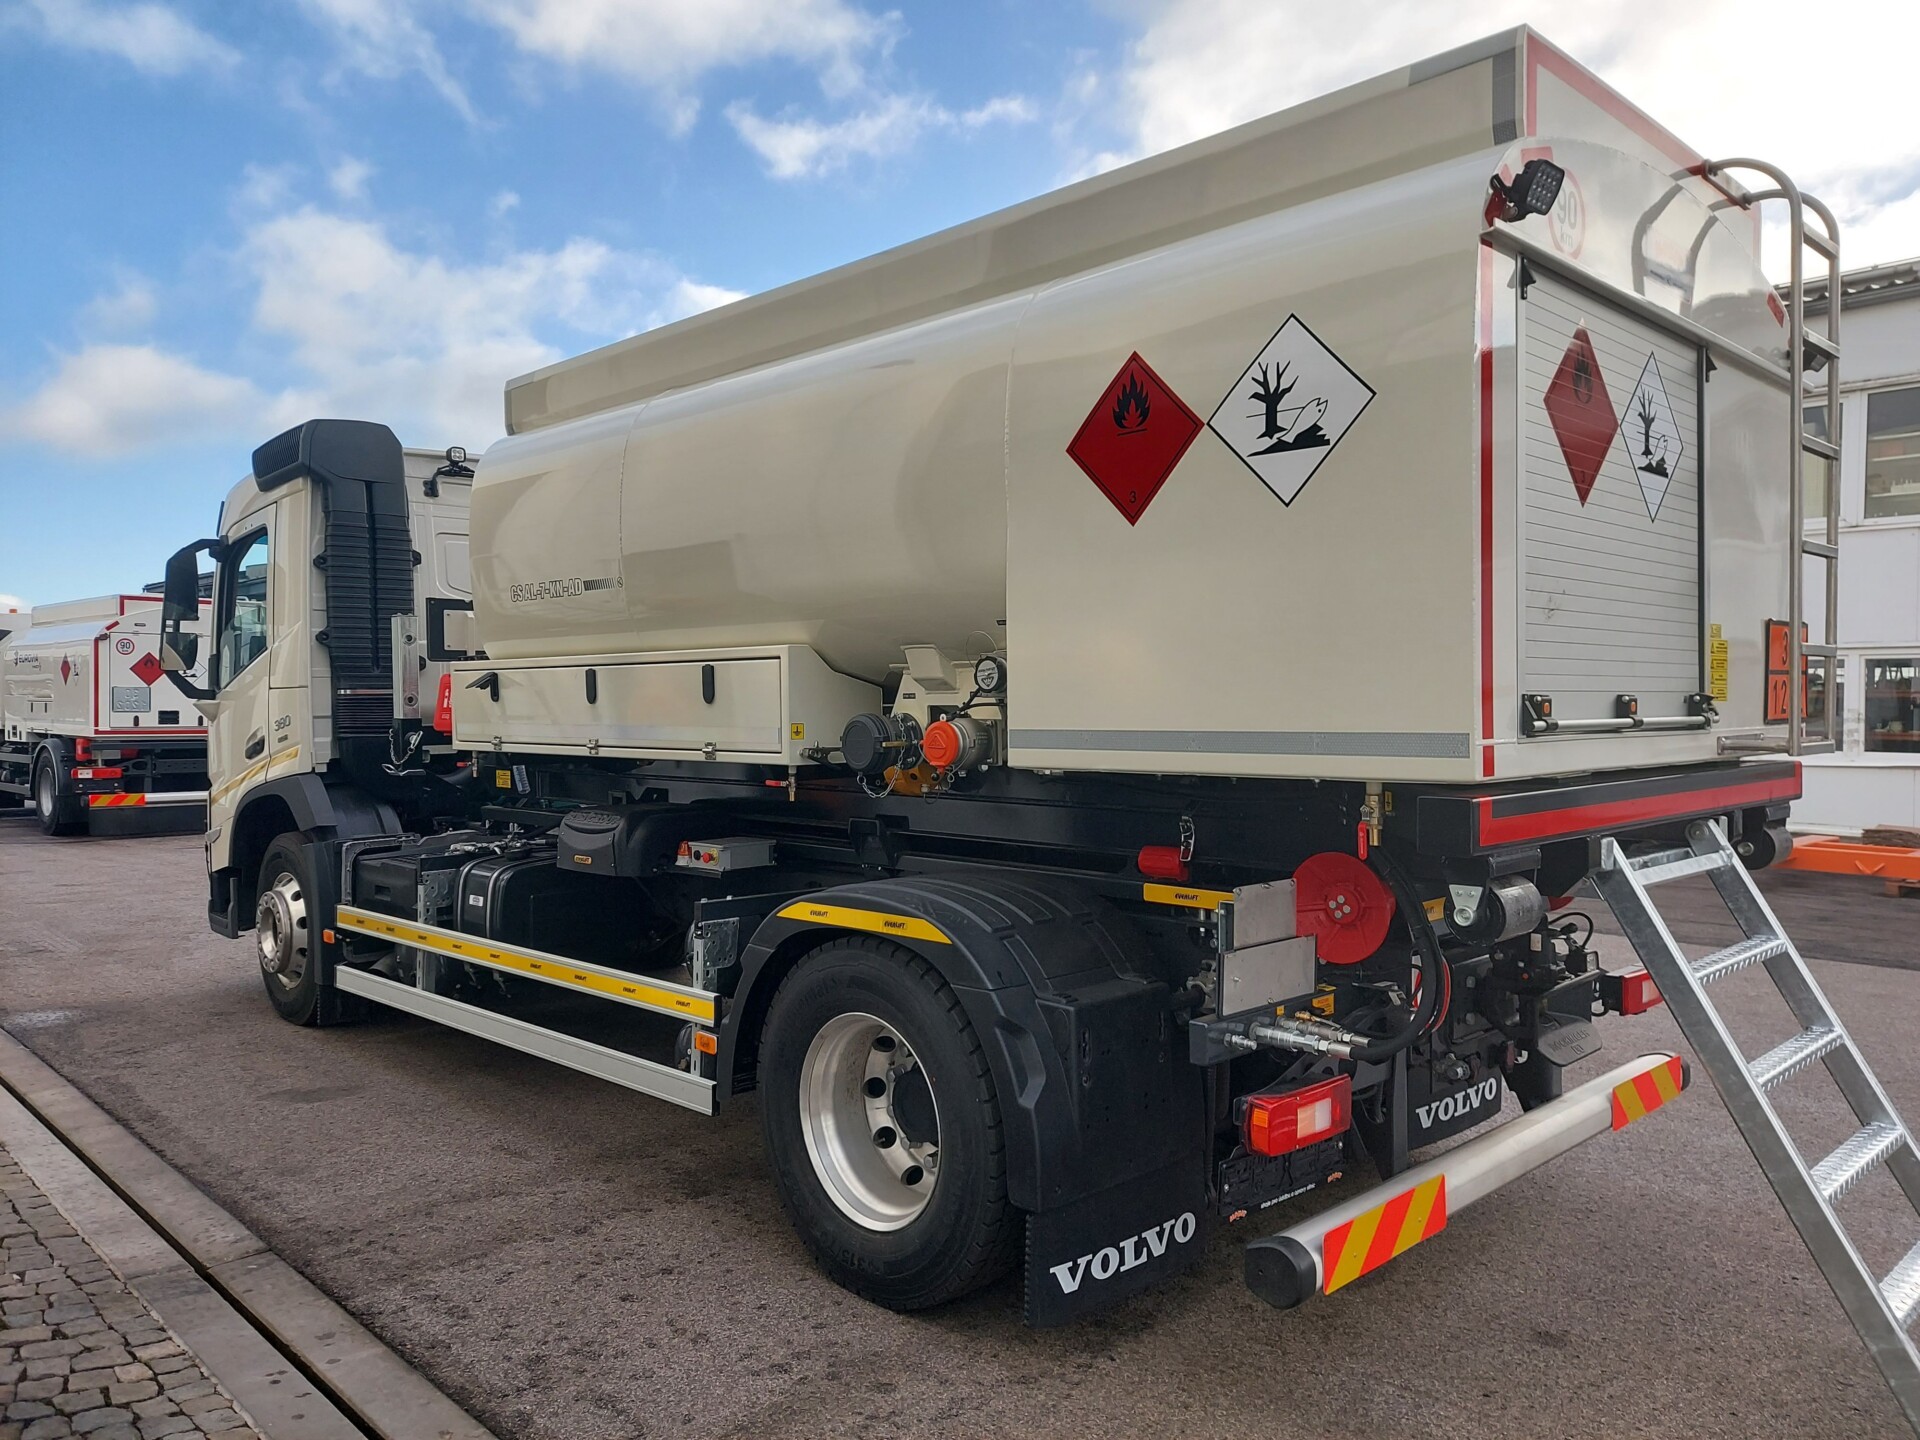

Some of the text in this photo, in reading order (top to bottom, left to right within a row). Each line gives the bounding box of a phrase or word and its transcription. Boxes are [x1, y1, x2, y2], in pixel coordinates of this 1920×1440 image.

[1556, 185, 1577, 230] 90
[1129, 490, 1137, 504] 3
[119, 641, 131, 650] 90
[1415, 1077, 1497, 1129] VOLVO
[1050, 1212, 1196, 1294] VOLVO
